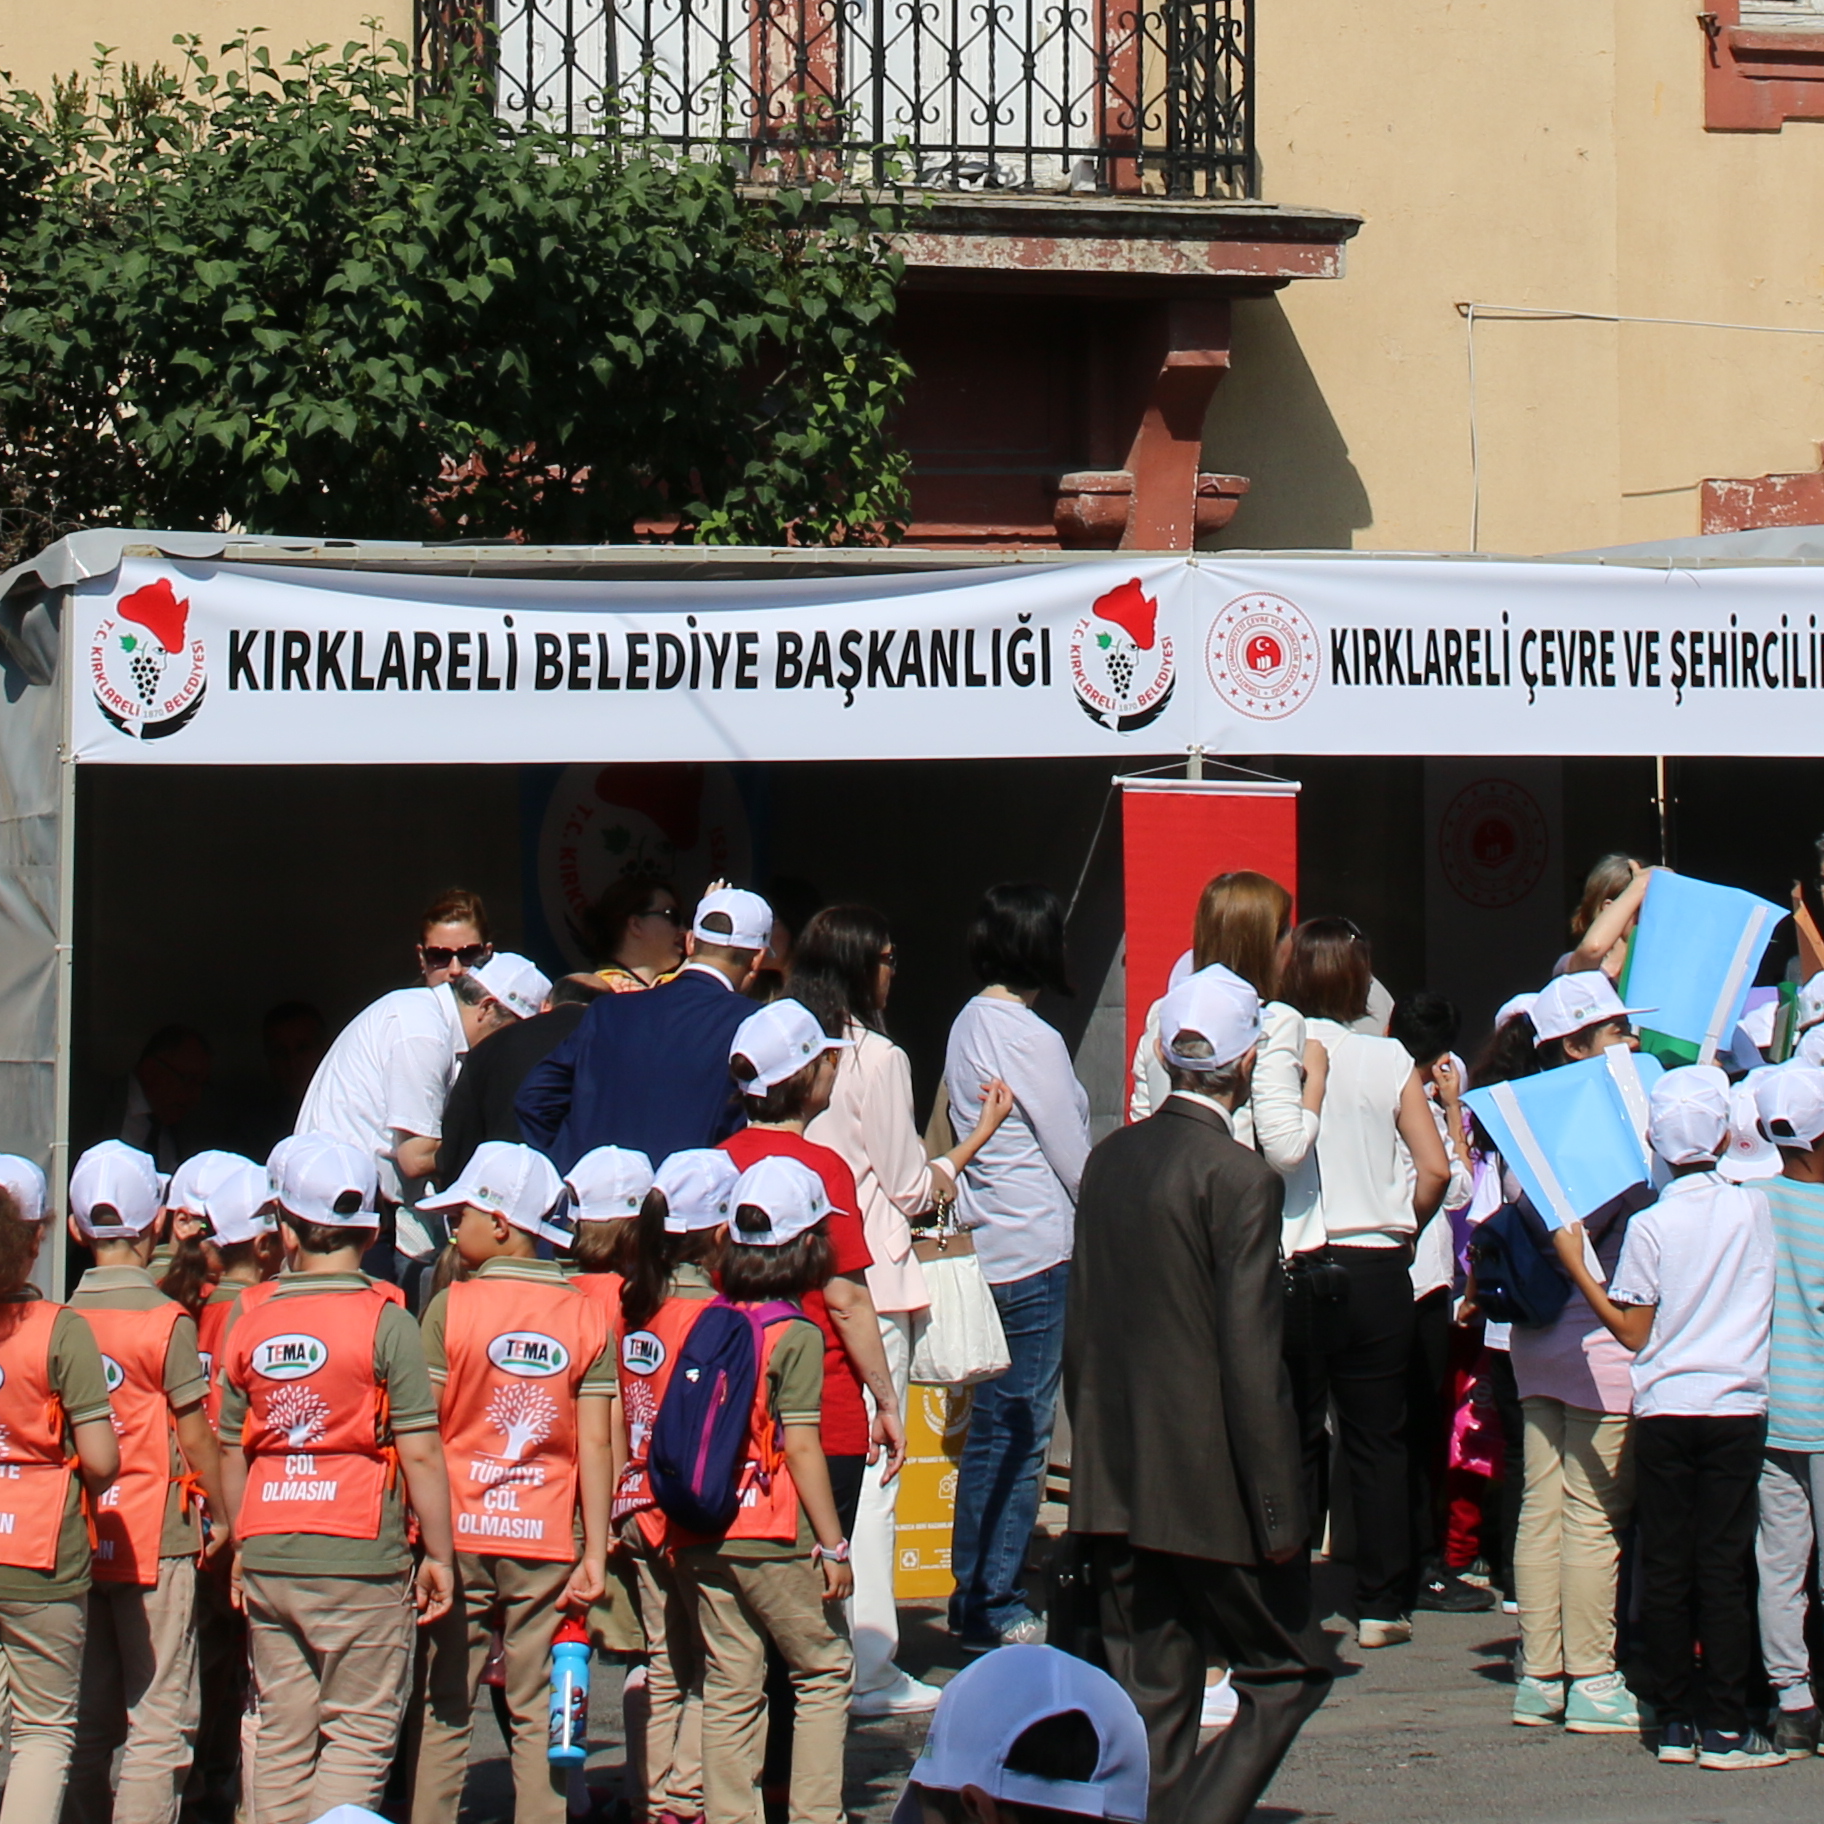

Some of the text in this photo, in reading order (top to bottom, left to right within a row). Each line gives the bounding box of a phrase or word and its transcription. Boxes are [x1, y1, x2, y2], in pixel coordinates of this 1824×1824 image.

[227, 613, 1051, 707] KIRKLARELİ BELEDİYE BAŞKANLIĞI
[1070, 644, 1117, 710] KIRKLARELİ
[1137, 636, 1173, 707] BELEDİYESİ
[1330, 611, 1511, 688] KIRKLARELİ
[1521, 628, 1620, 707] ÇEVRE
[1623, 631, 1662, 688] VE
[91, 646, 142, 717] KIRKLARELİ
[164, 640, 205, 713] BELEDİYESİ
[143, 709, 165, 719] 1870
[266, 1343, 306, 1364] TEMA
[505, 1338, 549, 1362] TEMA
[469, 1459, 546, 1487] TÜRKİYE
[262, 1480, 338, 1503] OLMASIN
[483, 1484, 521, 1515] ÇÖL
[457, 1513, 545, 1540] OLMASIN
